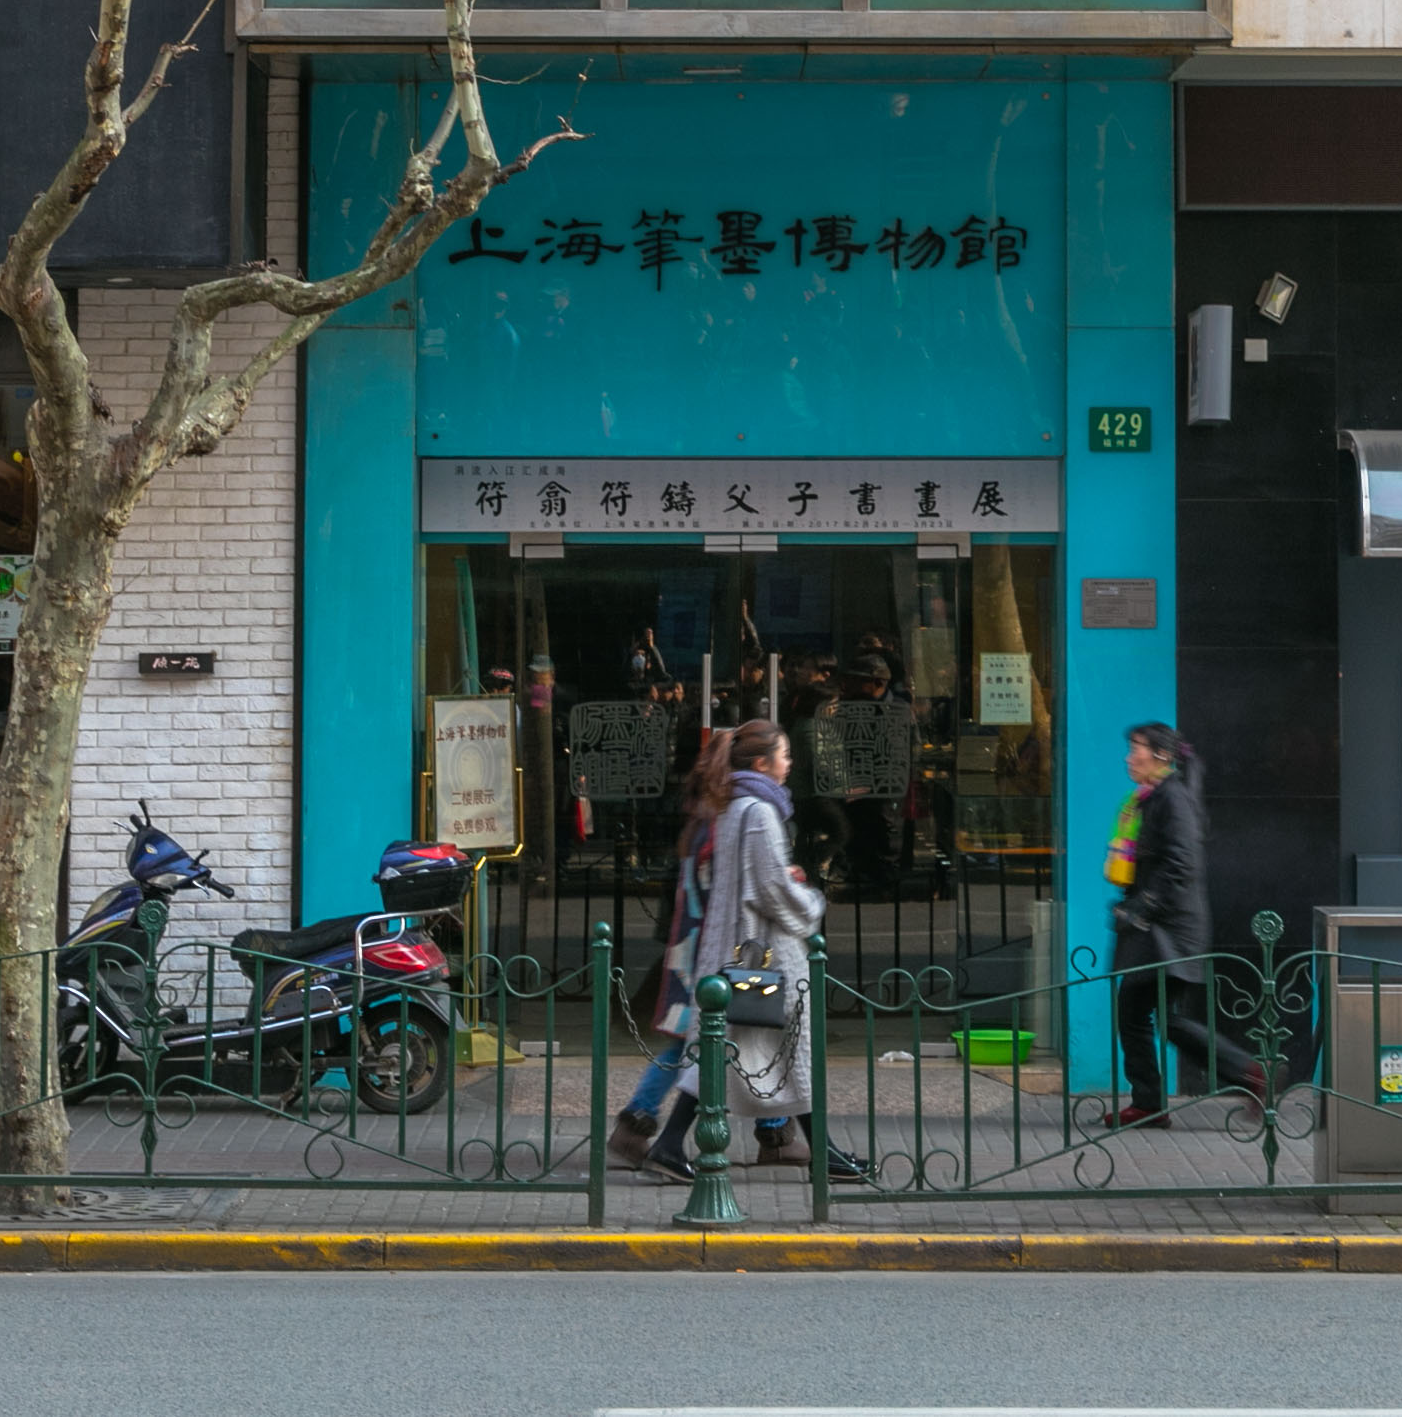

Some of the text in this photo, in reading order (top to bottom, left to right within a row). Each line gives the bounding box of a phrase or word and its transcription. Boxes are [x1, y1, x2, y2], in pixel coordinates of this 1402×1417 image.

[448, 208, 1029, 290] 上海筆墨博物館
[1098, 413, 1142, 435] 429
[451, 789, 495, 805] 二楼展示
[453, 817, 497, 834] 免费参观
